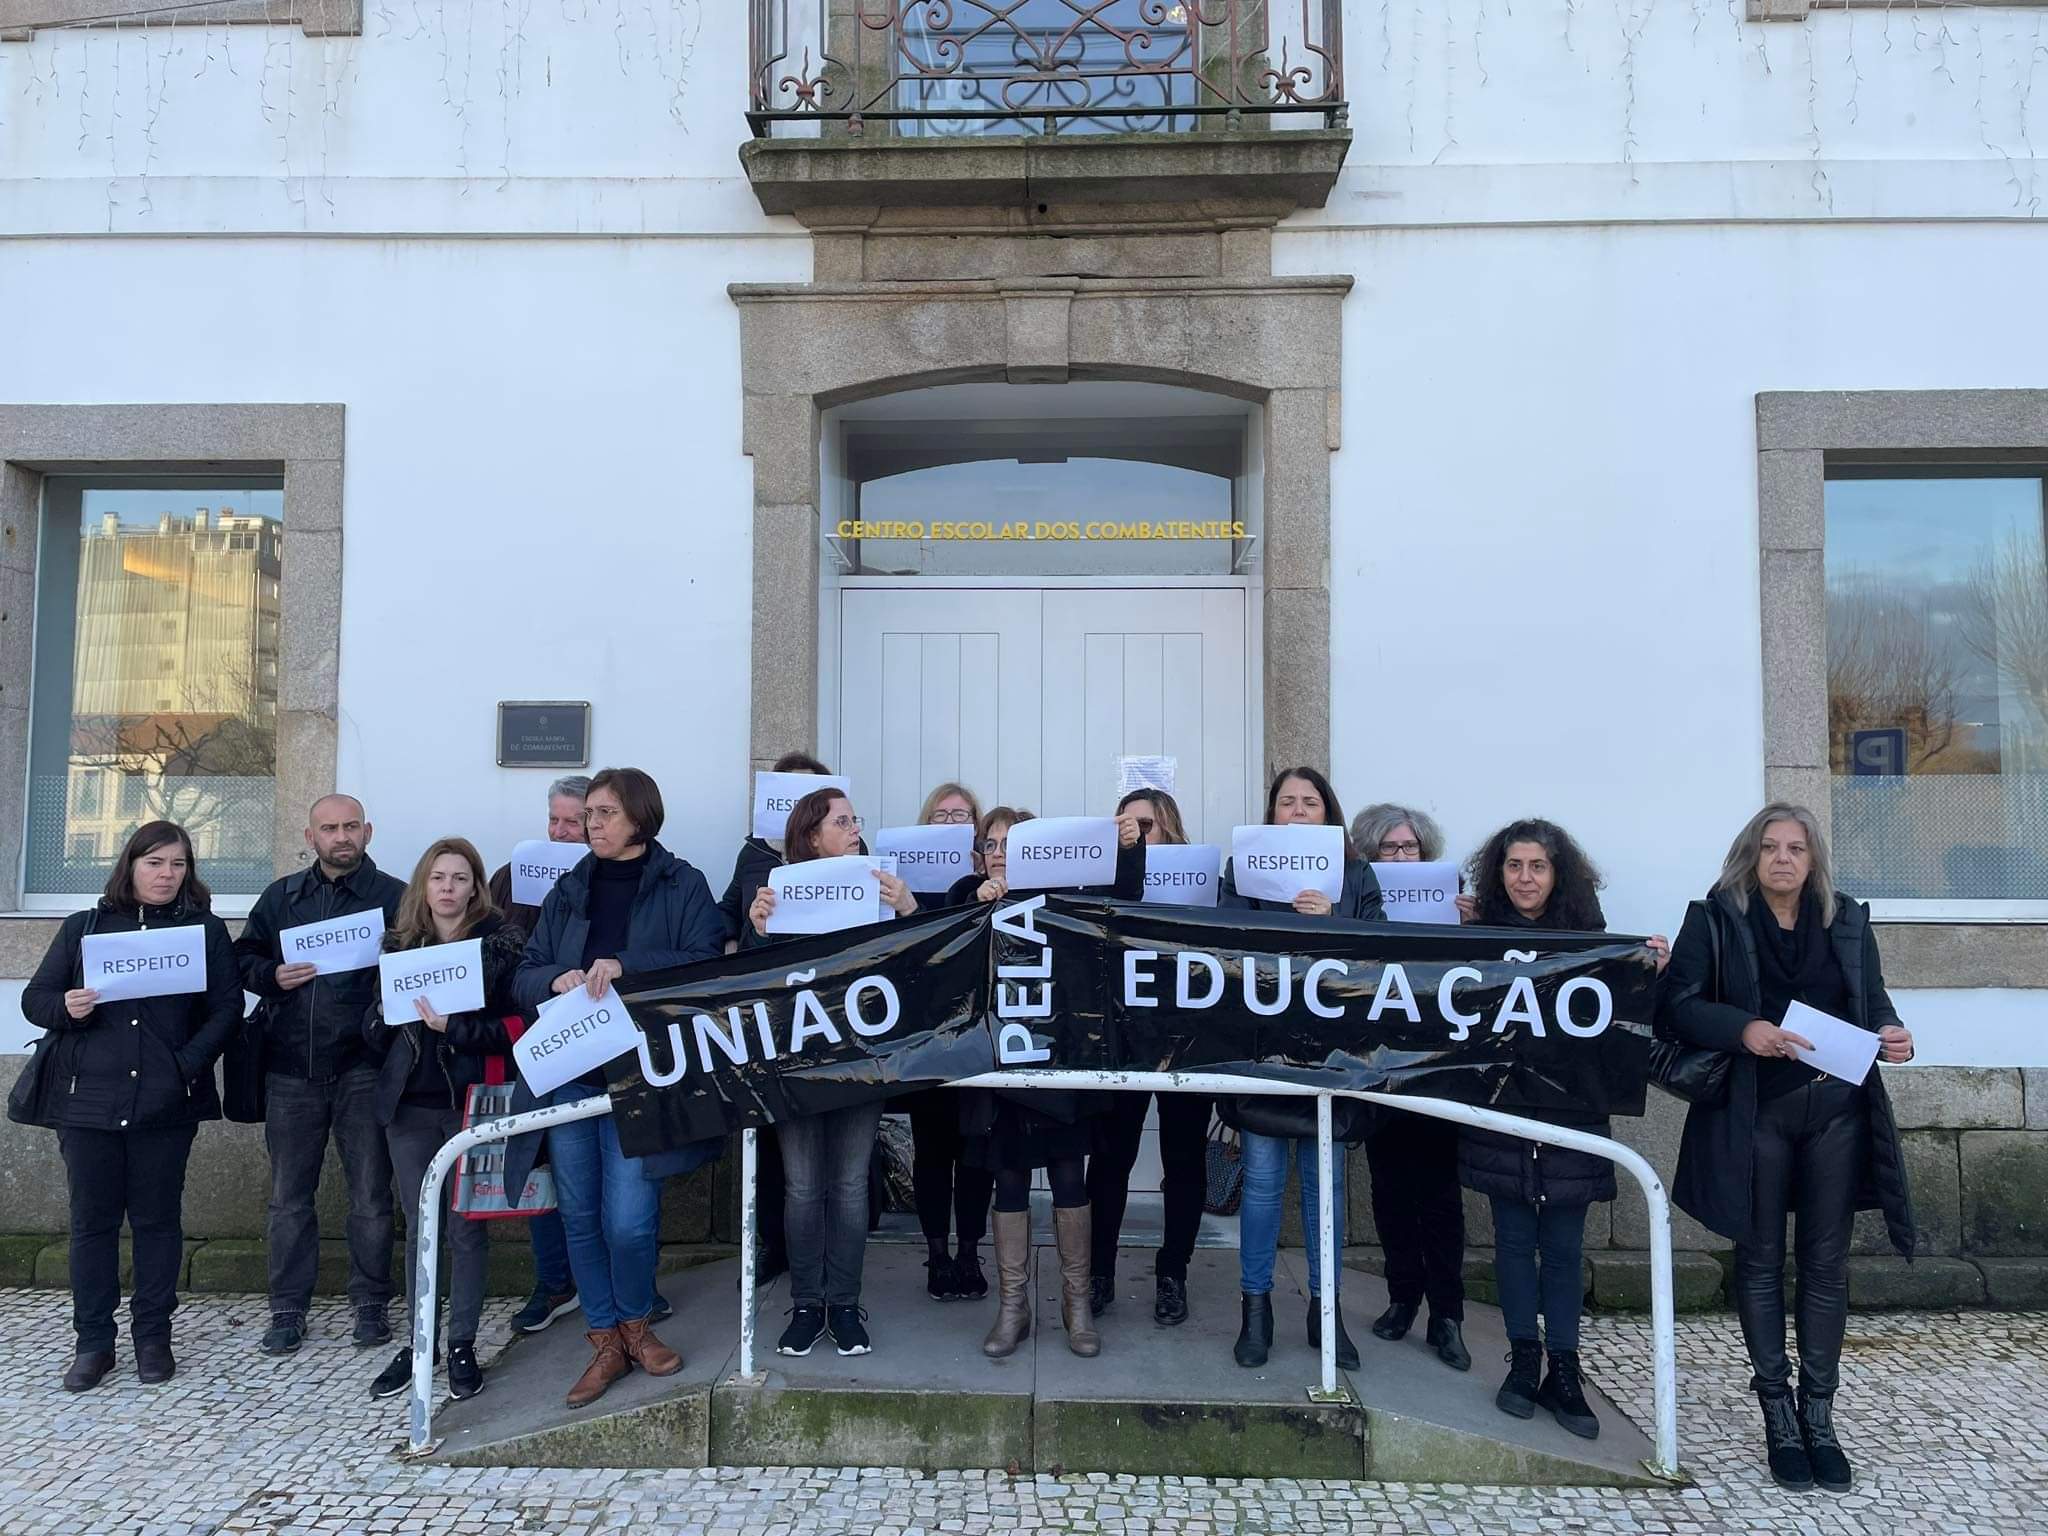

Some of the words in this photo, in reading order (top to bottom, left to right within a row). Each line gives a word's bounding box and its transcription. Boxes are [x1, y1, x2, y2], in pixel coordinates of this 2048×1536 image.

[838, 520, 924, 540] CENTRO
[931, 520, 1028, 540] ESCOLAR
[1035, 520, 1080, 540] DOS
[1085, 520, 1245, 540] COMBATENTES
[1021, 845, 1102, 860] RESPEITO
[1247, 855, 1329, 871] RESPEITO
[1145, 872, 1207, 886] ESPEITO
[783, 885, 864, 901] RESPEITO
[1381, 889, 1445, 903] ESPEITO
[294, 925, 372, 952] RESPEITO
[103, 952, 190, 974] RESPEITO
[393, 964, 468, 993] RESPEITO
[637, 967, 901, 1088] UNIÃO
[990, 894, 1053, 1065] PELA
[1123, 948, 1613, 1042] EDUCAÇÃO
[529, 1007, 611, 1063] RESPEITO
